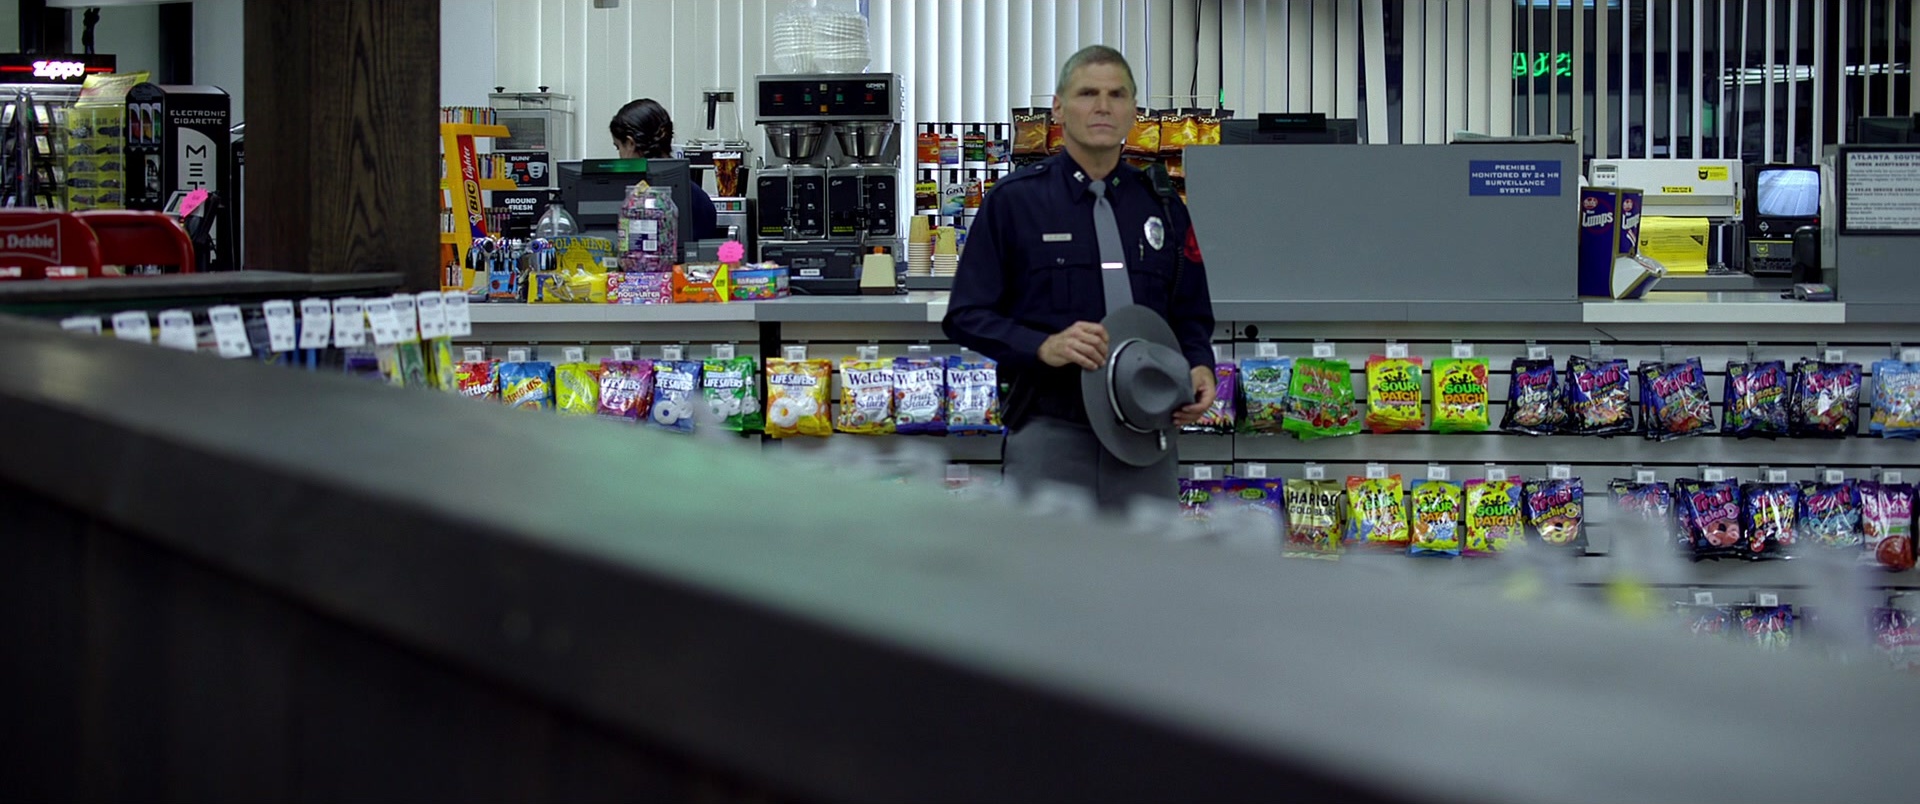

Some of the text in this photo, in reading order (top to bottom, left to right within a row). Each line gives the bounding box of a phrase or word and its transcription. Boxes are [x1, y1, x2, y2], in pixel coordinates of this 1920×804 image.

[170, 109, 226, 117] ELECTRONIC
[174, 117, 222, 125] CIGARETTE
[467, 183, 479, 212] BIC
[1582, 211, 1614, 227] Lumps
[7, 233, 55, 249] Debbie
[896, 370, 940, 385] Wlch's
[459, 381, 494, 396] ittles
[1380, 381, 1415, 391] SOUR
[1445, 384, 1481, 394] SOUR
[1380, 391, 1418, 402] PATCH
[1444, 393, 1484, 404] PATCH
[1290, 491, 1338, 506] HARIBO
[1290, 506, 1312, 514] GOLD
[1476, 506, 1512, 517] SOUR
[1475, 515, 1514, 527] PATCH
